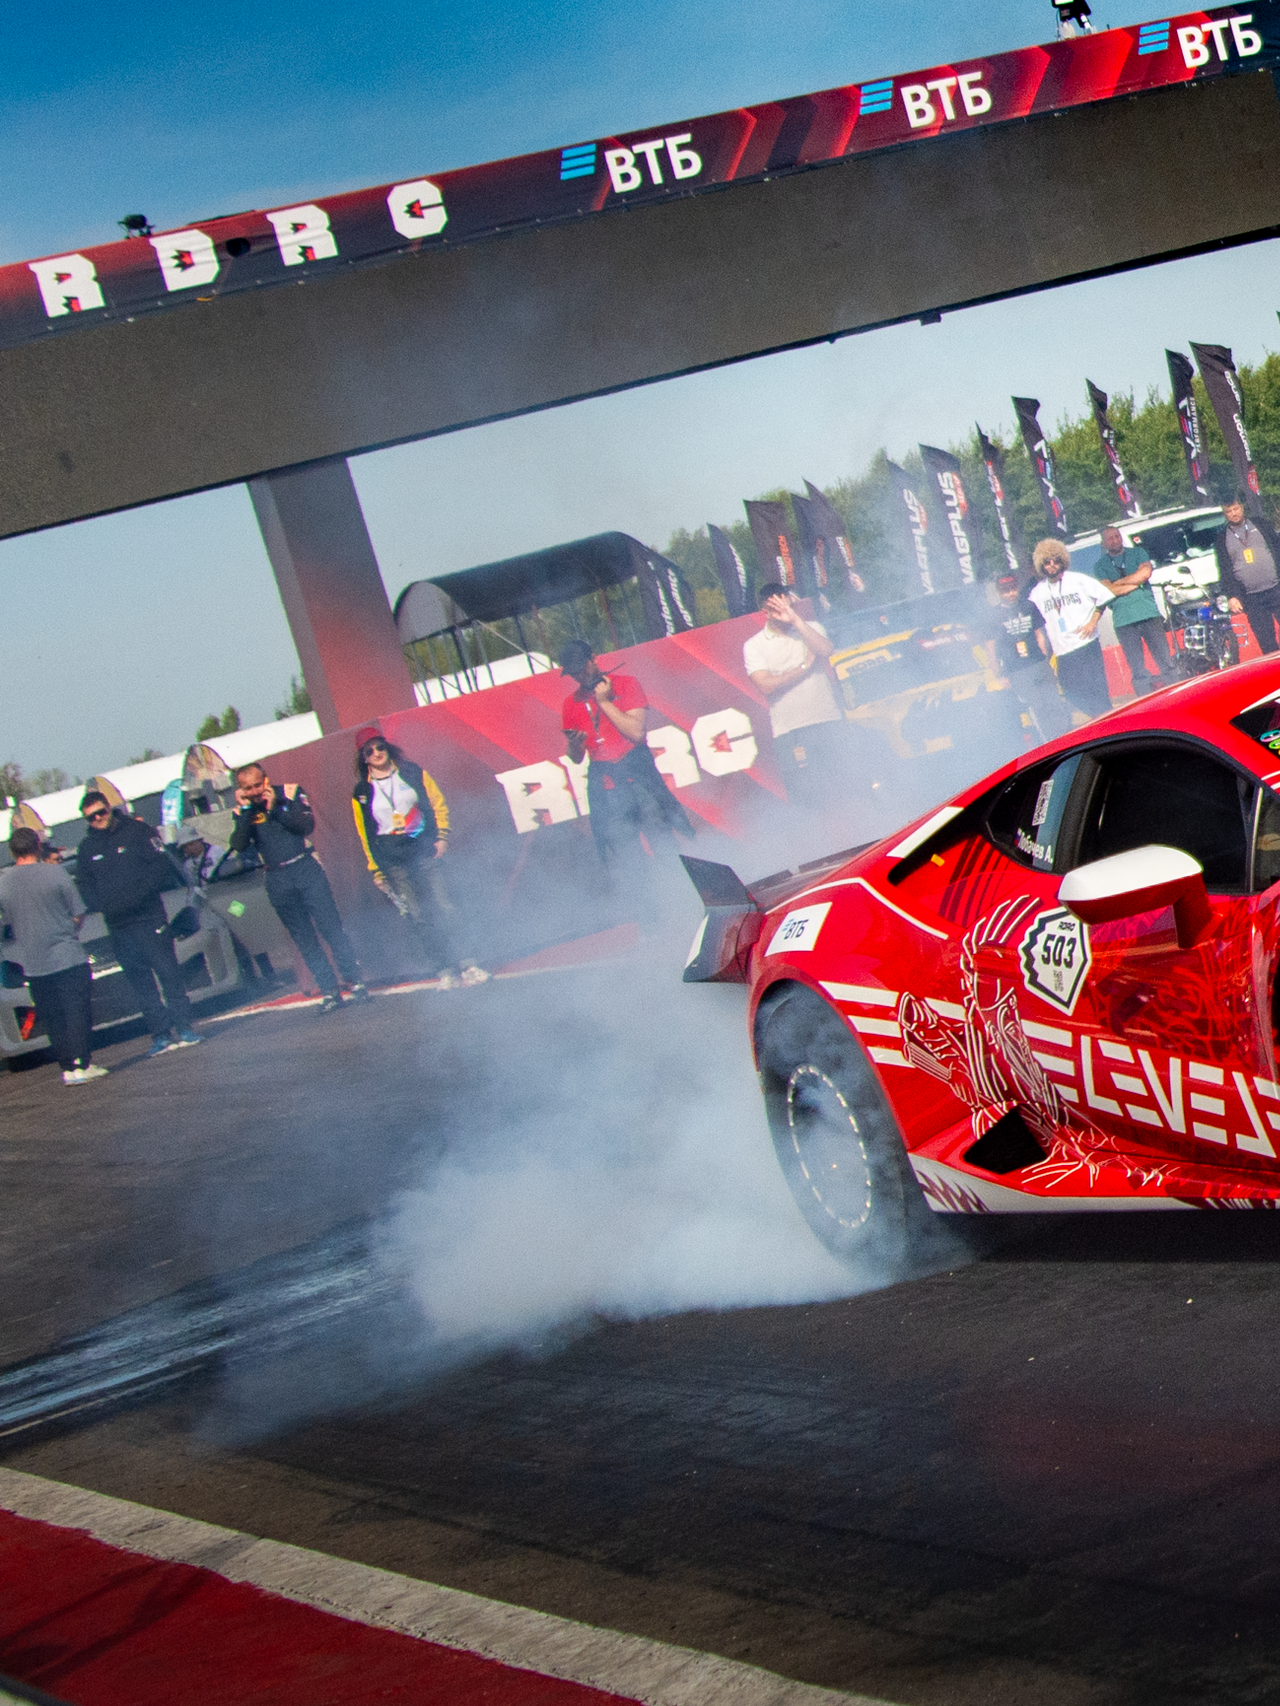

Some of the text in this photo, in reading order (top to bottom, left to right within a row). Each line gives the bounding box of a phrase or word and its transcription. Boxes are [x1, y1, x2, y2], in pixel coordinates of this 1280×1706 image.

[1177, 14, 1263, 68] ВТБ
[900, 72, 992, 128] ВТБ
[604, 133, 702, 193] ВТБ
[783, 919, 809, 940] ВТБ
[1041, 933, 1077, 969] 503
